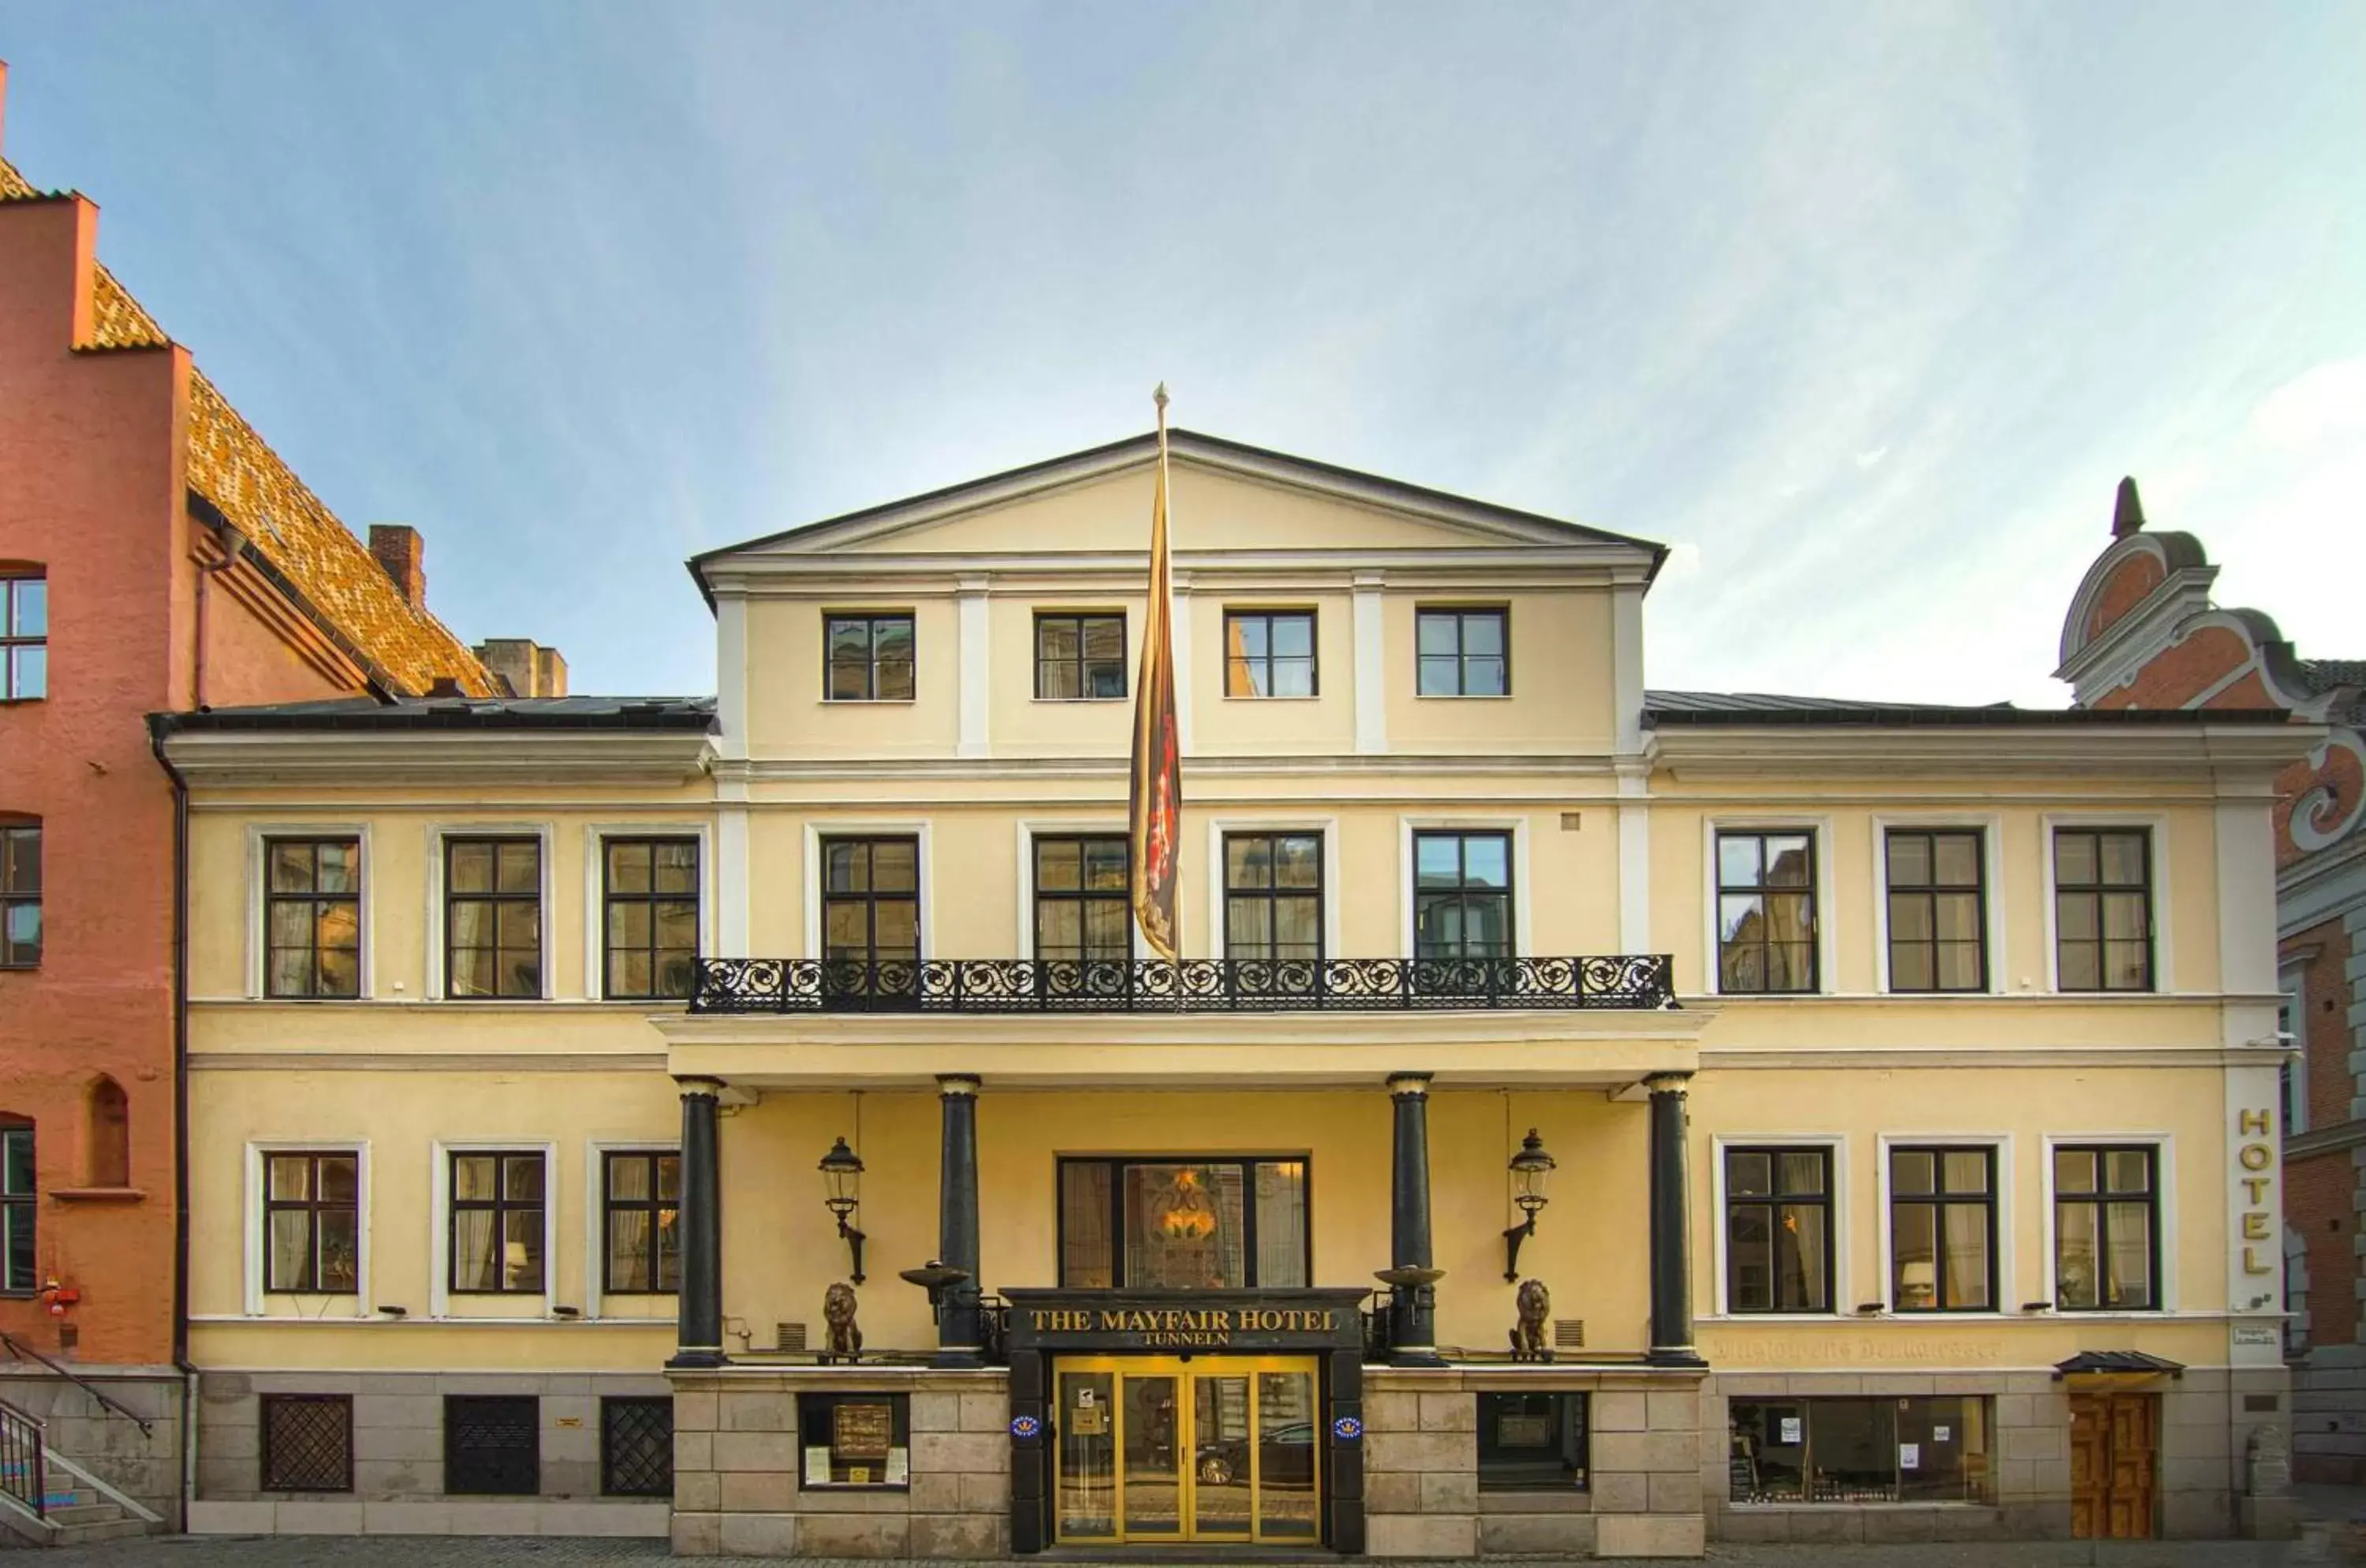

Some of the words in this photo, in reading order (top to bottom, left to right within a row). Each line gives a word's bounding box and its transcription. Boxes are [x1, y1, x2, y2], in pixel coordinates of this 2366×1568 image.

[2239, 1108, 2273, 1275] HOTEL
[1029, 1310, 1092, 1331] THE
[1100, 1310, 1231, 1331] MAYFAIR
[1237, 1310, 1340, 1331] HOTEL
[1144, 1331, 1229, 1345] TUNNELN
